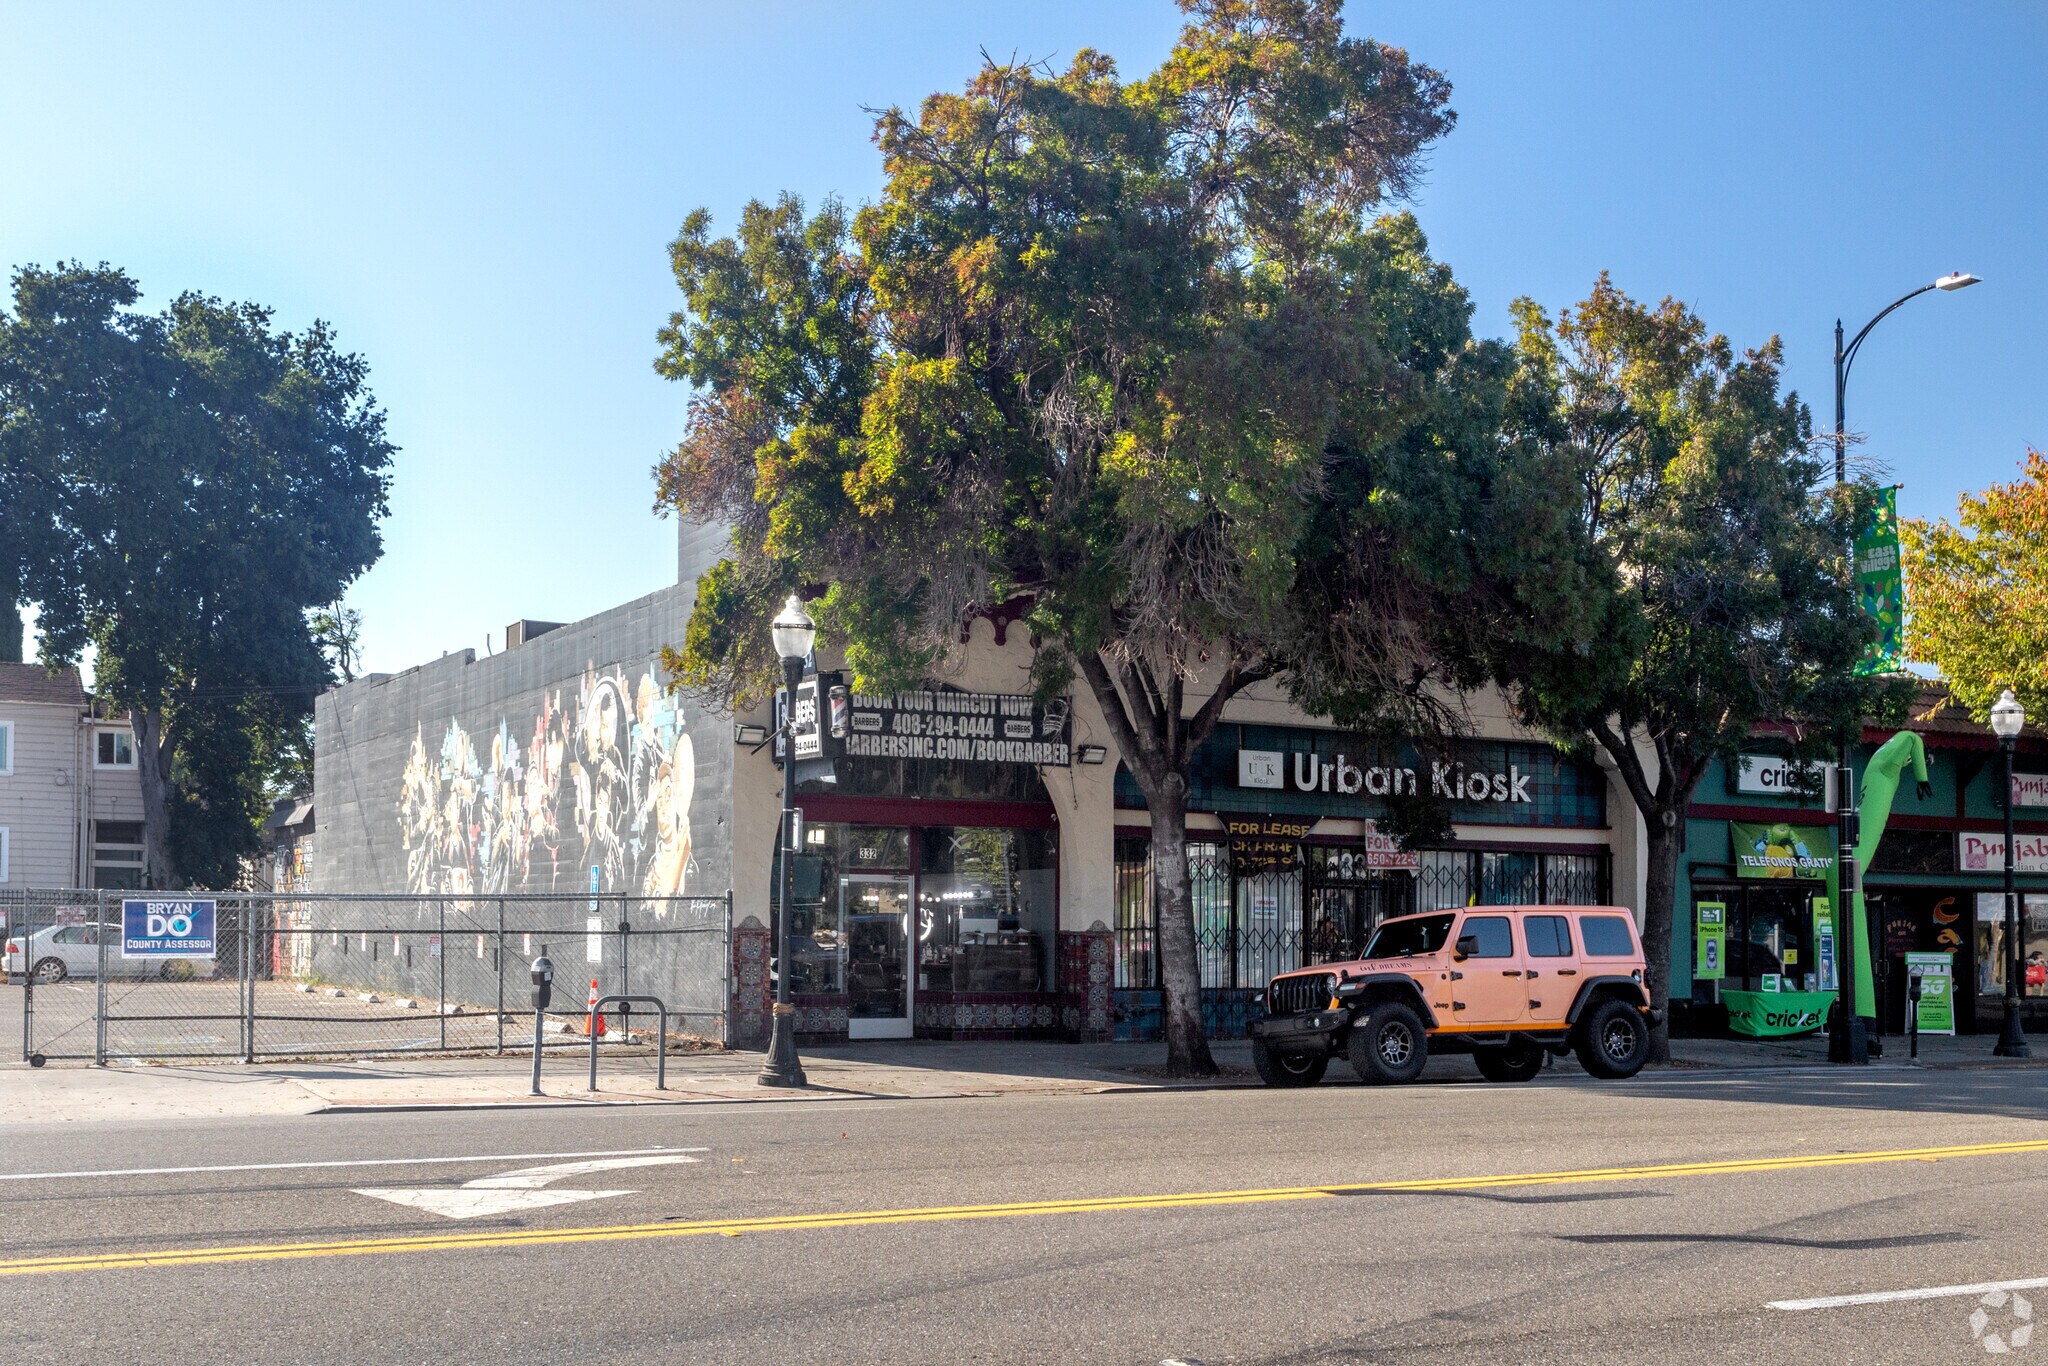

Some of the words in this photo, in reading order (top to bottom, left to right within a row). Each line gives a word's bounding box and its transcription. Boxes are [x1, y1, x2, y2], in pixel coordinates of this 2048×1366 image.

[1868, 545, 1895, 559] East
[1860, 555, 1896, 573] Village
[896, 690, 933, 711] YOUR
[937, 692, 997, 714] HAIRCUT
[855, 716, 880, 726] BARBERS
[892, 713, 994, 738] 408-294-0444
[1006, 724, 1031, 733] BARBERS
[1252, 754, 1271, 762] Urban
[1253, 776, 1270, 785] Kiosk
[1294, 752, 1417, 796] Urban
[1431, 761, 1532, 803] Kiosk
[1229, 822, 1260, 835] FOR
[1262, 823, 1311, 836] LEASE
[1367, 836, 1390, 851] FOR
[860, 849, 876, 859] 332
[146, 903, 192, 914] BRYAN
[147, 914, 192, 937] DO
[127, 939, 162, 949] COUNTY
[164, 939, 212, 949] ASSESSOR
[1378, 962, 1412, 971] DREAMS
[1921, 980, 1946, 995] 5G
[1766, 1008, 1822, 1028] cricket
